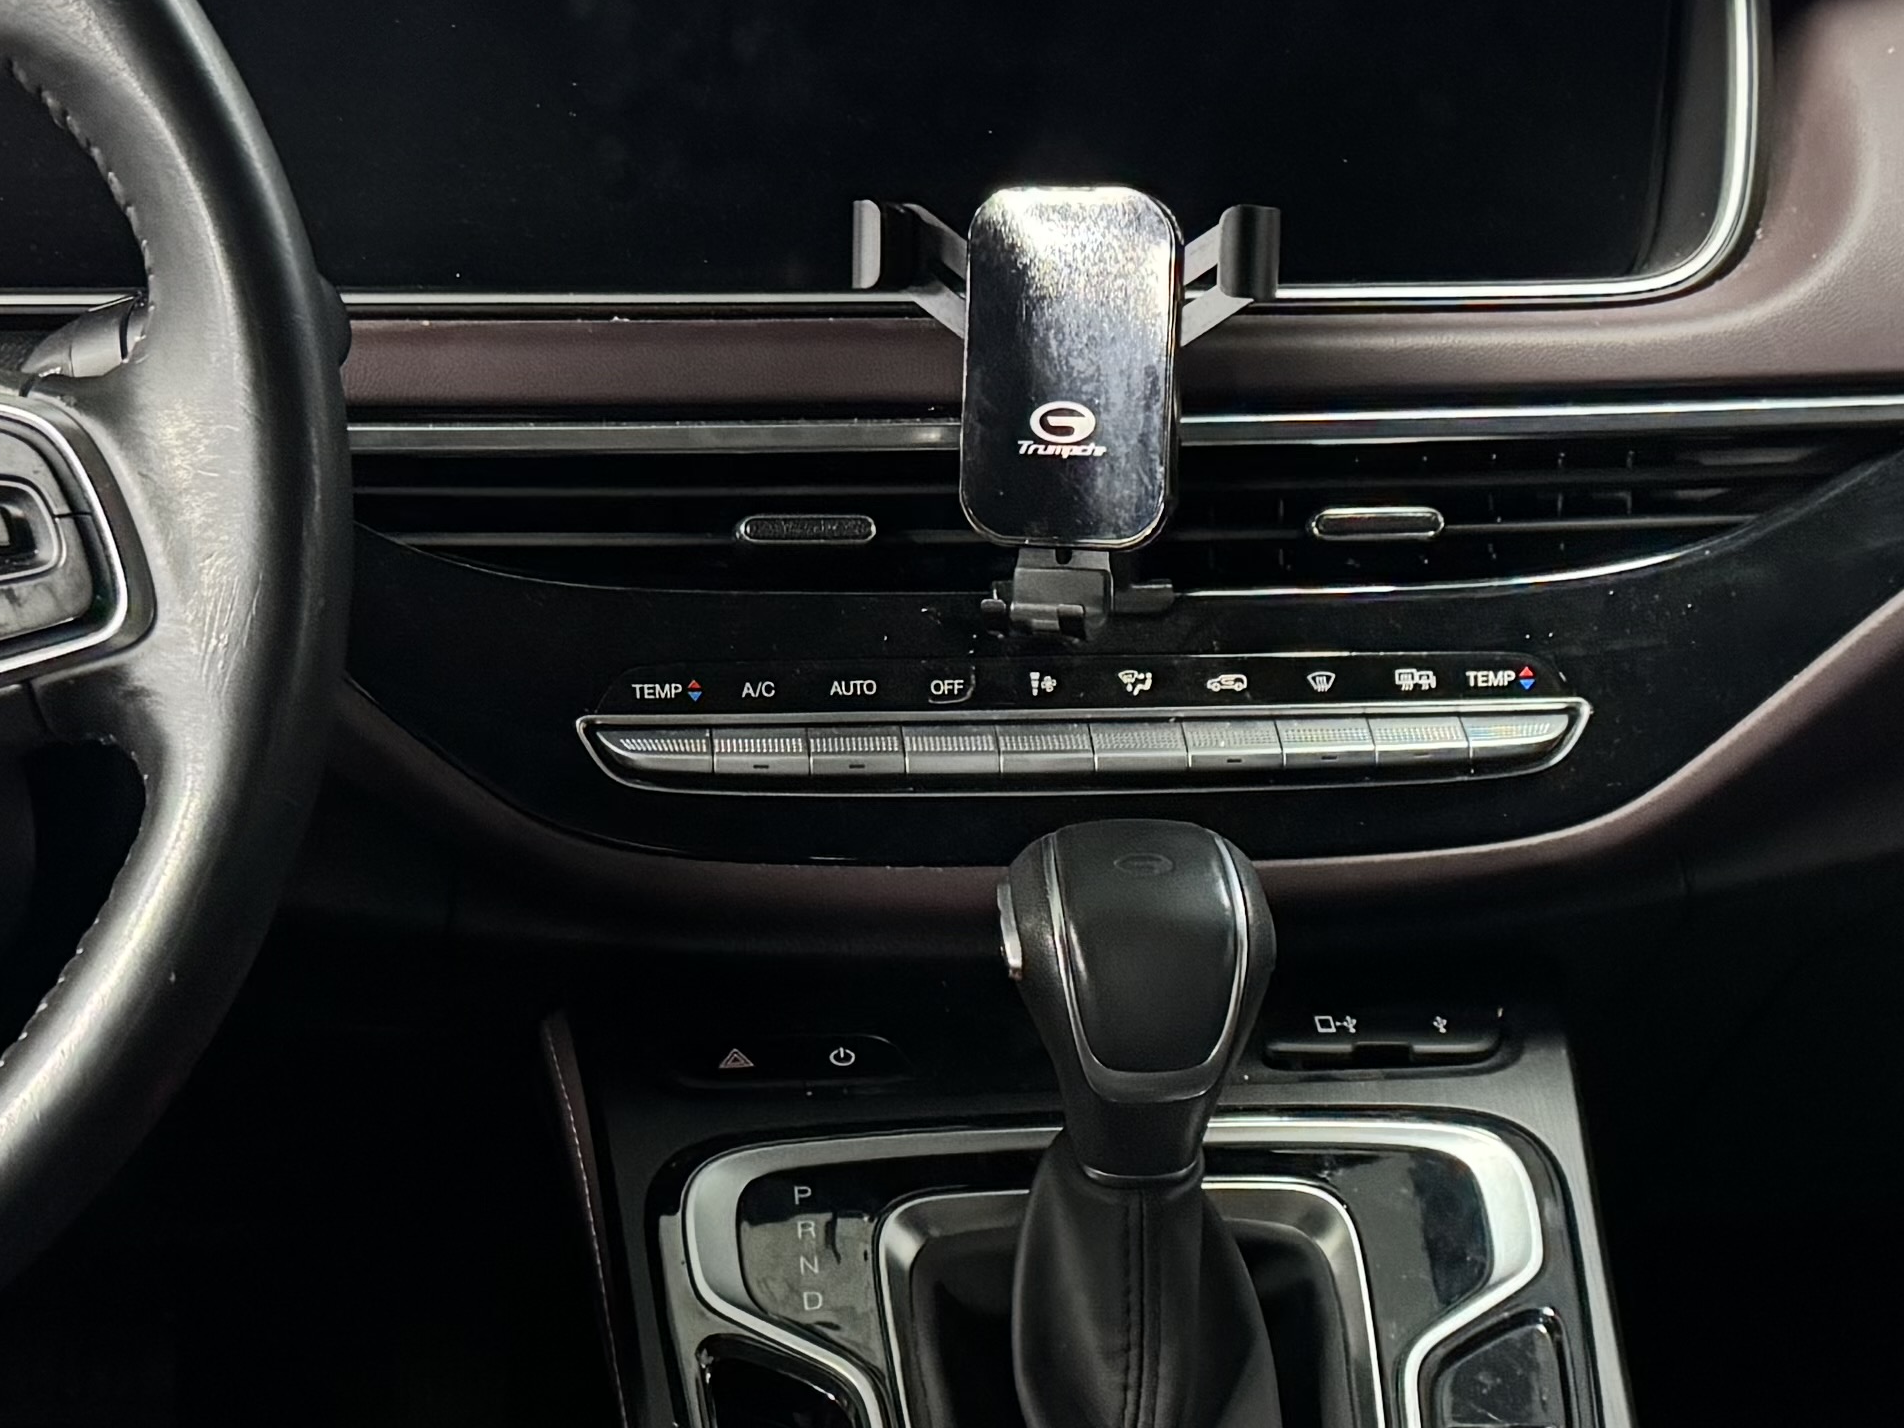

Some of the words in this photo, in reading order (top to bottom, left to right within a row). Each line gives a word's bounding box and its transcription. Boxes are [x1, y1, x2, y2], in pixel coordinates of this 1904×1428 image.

[830, 679, 877, 696] AUTO
[930, 679, 964, 696] OFF
[1465, 669, 1516, 688] TEMP
[632, 683, 683, 700] TEMP
[741, 682, 776, 699] A/C
[793, 1186, 812, 1206] P
[797, 1221, 816, 1241] R
[800, 1255, 819, 1276] N
[803, 1291, 824, 1312] D
